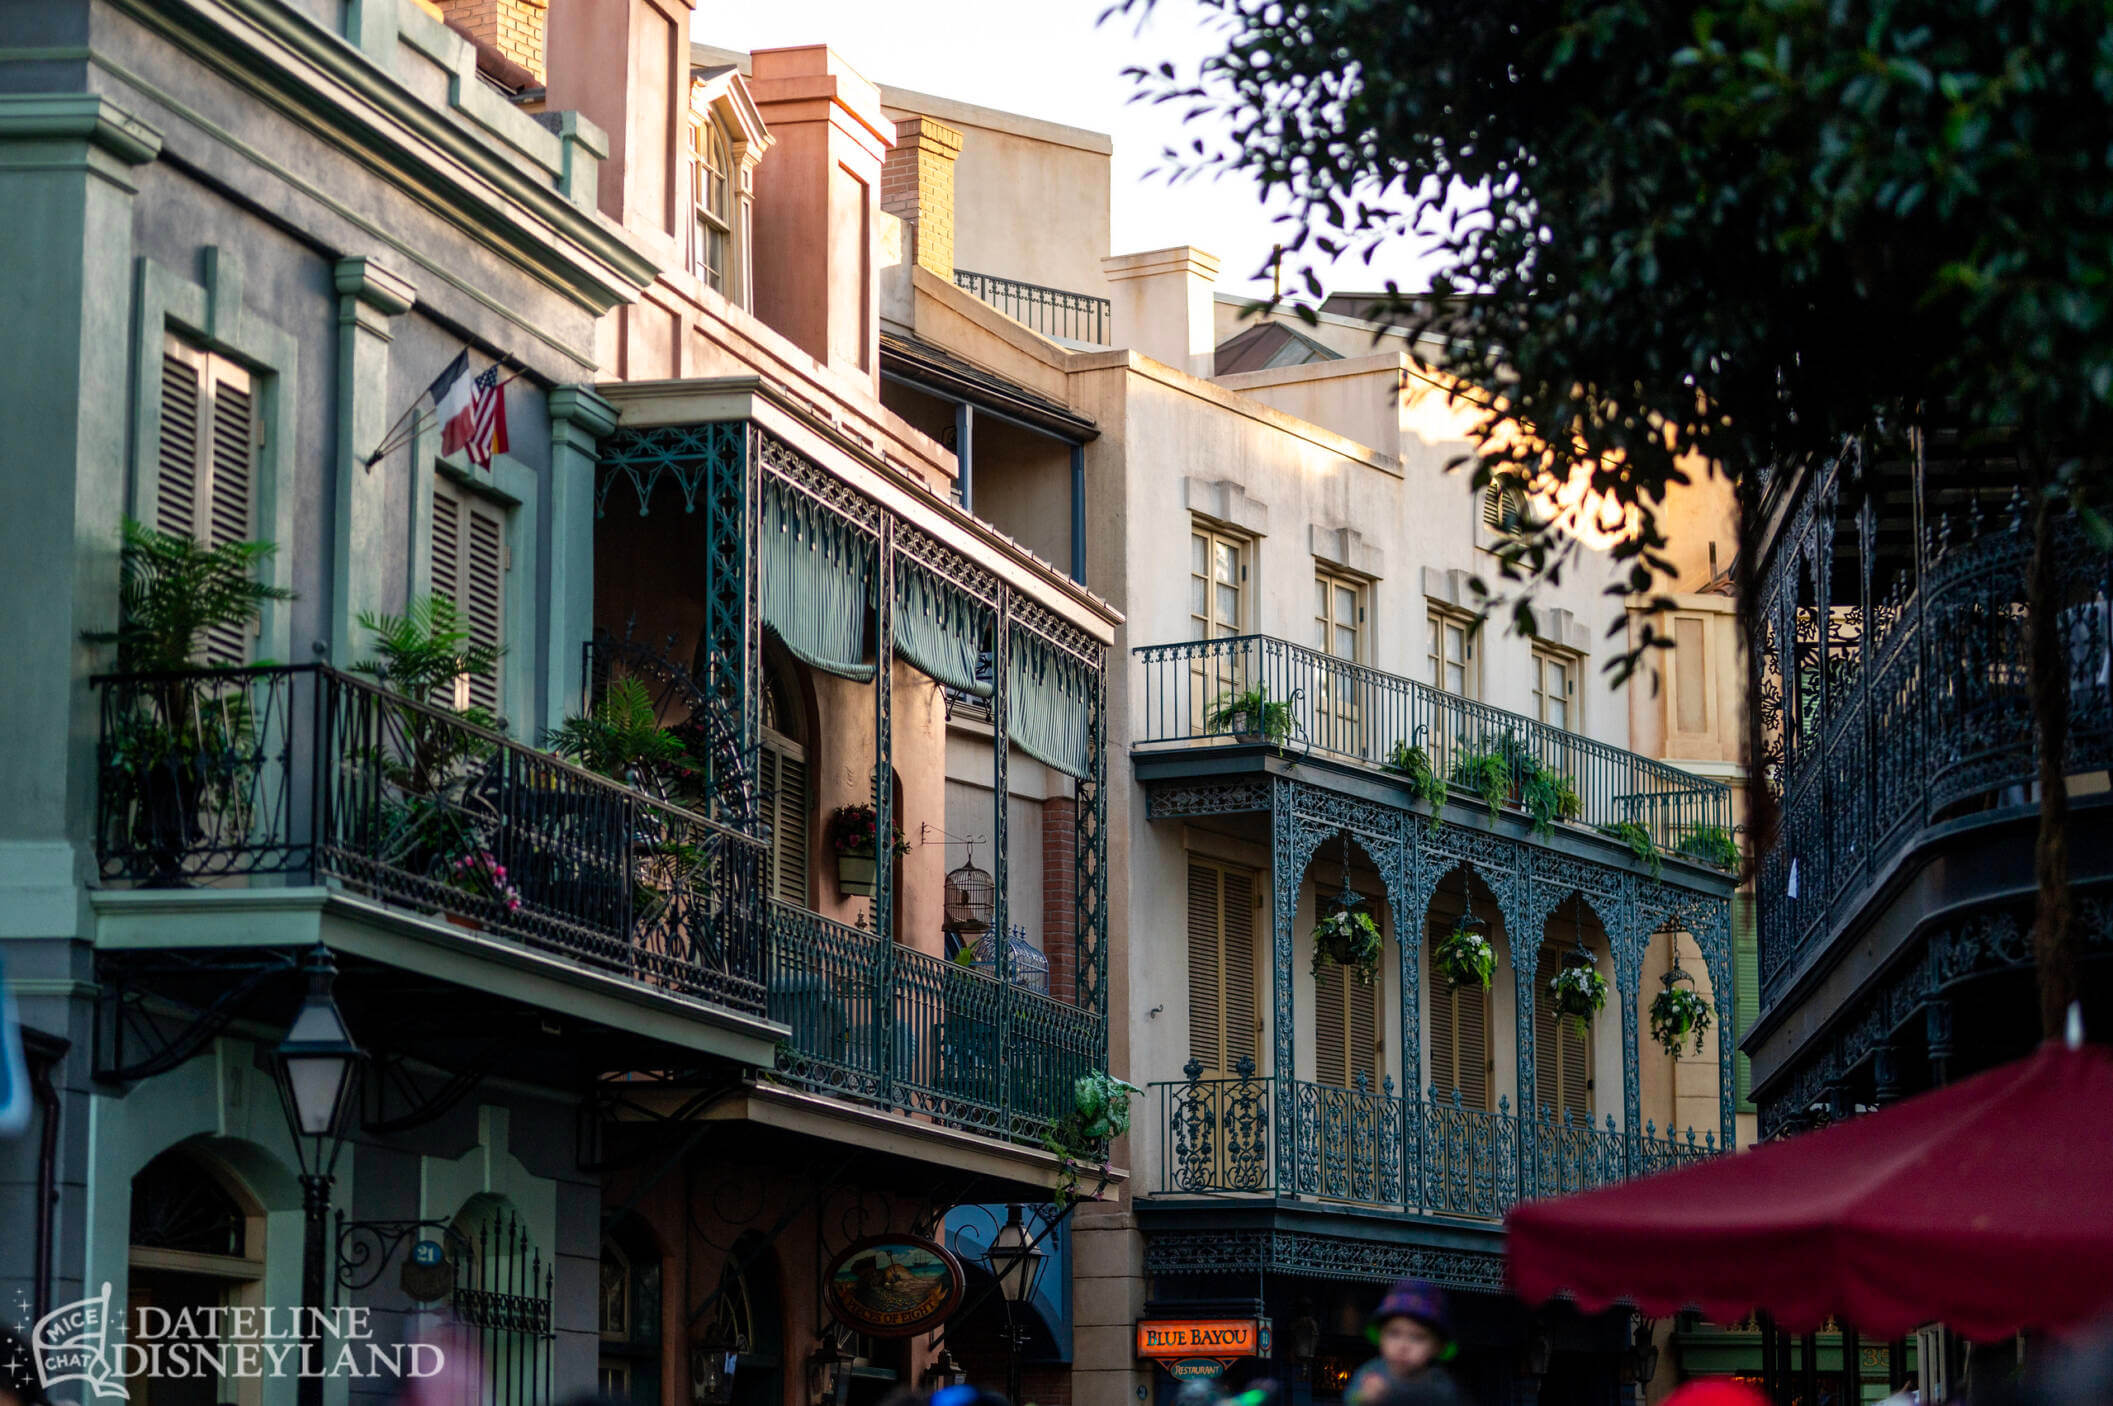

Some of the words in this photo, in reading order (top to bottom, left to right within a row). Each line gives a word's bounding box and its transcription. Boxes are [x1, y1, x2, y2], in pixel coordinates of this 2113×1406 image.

[417, 1245, 435, 1262] 21
[884, 1313, 898, 1323] OF
[901, 1303, 935, 1321] EIGHT
[1147, 1330, 1187, 1345] BLUE
[1190, 1329, 1247, 1344] BAYOU
[1175, 1364, 1219, 1376] RESTAURANT
